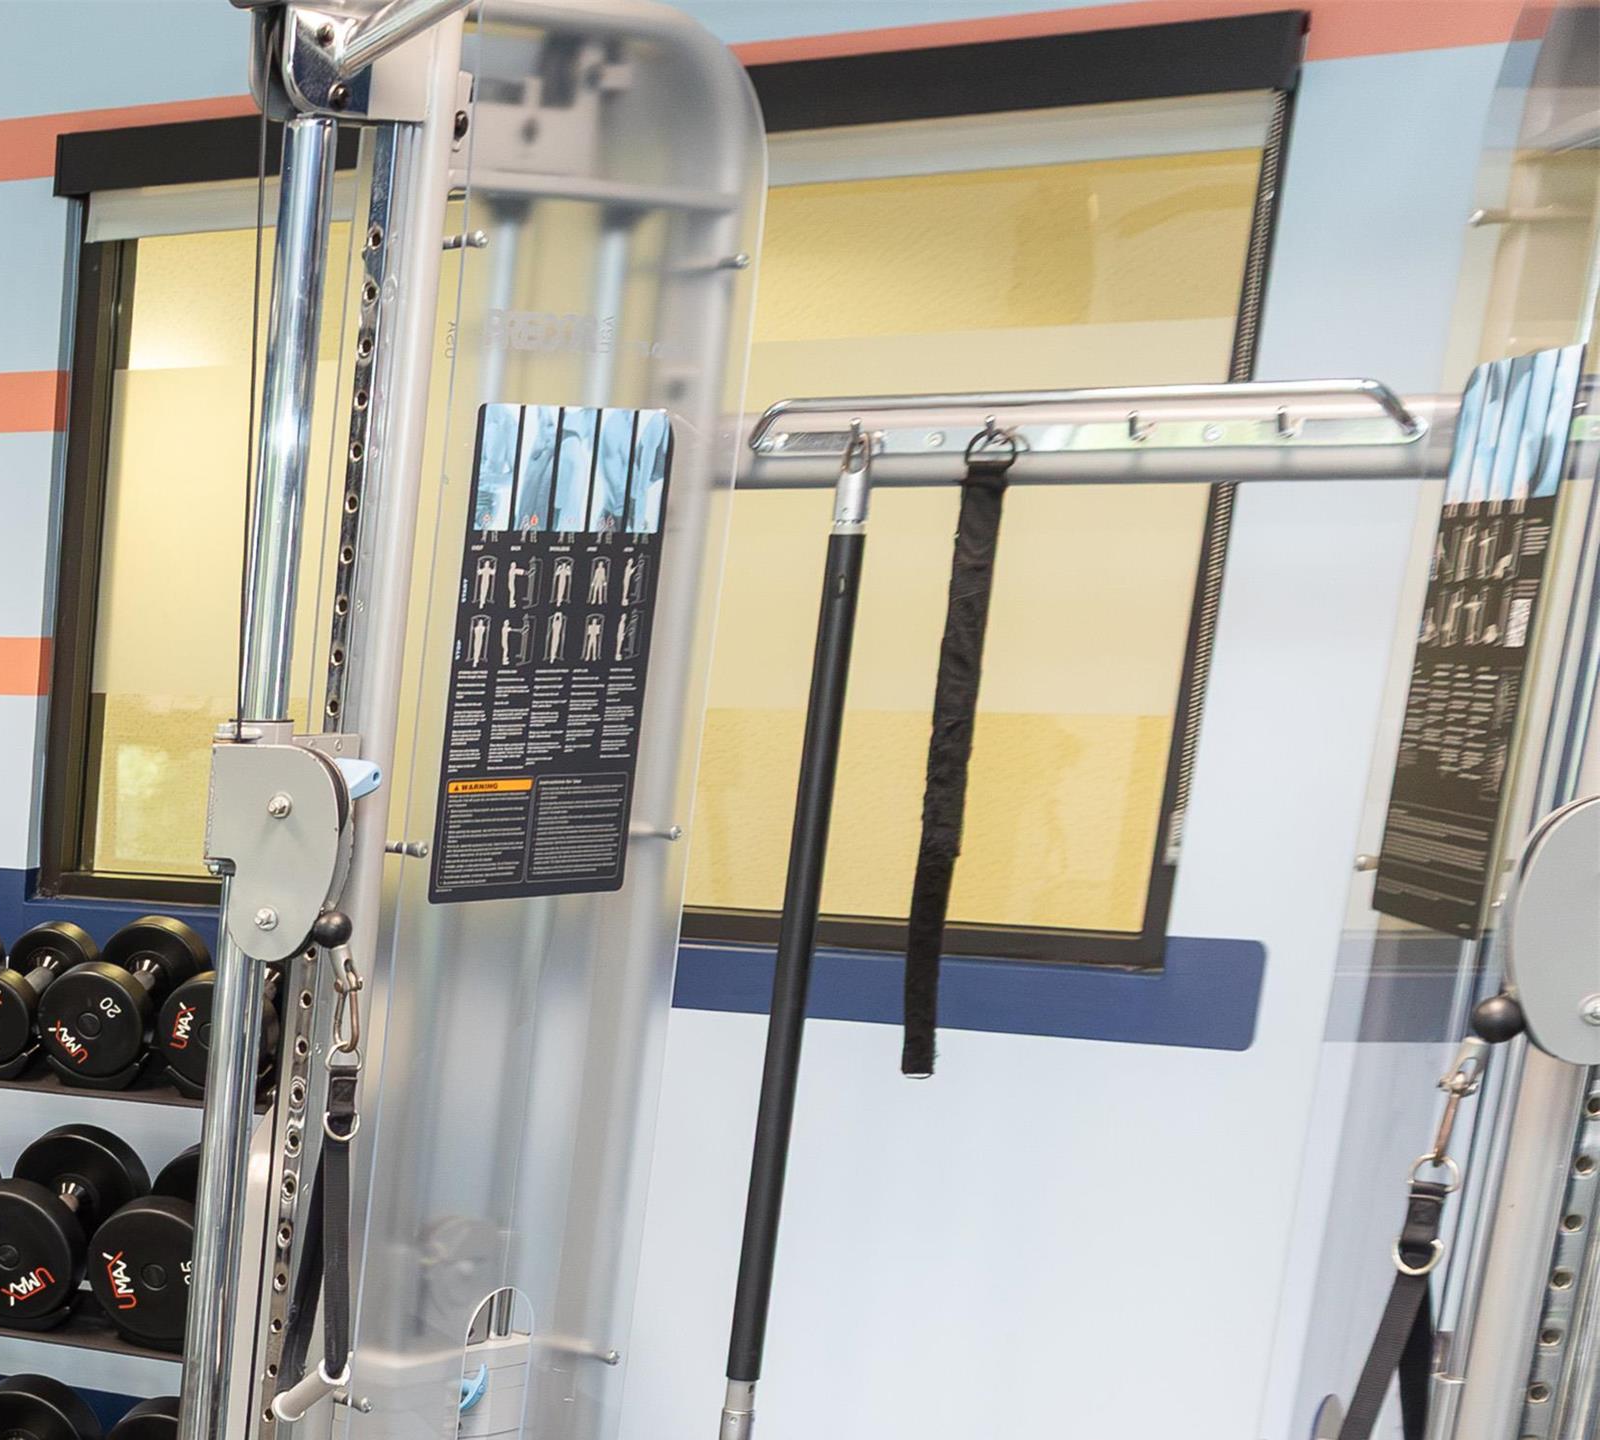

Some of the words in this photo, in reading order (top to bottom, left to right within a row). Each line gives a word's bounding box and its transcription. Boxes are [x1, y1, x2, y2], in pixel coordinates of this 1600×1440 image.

[461, 782, 499, 791] WARNING
[99, 997, 122, 1019] 20
[169, 1001, 197, 1050] UMAX
[47, 1020, 88, 1064] UMAX
[1, 1267, 55, 1307] UMAX
[102, 1251, 137, 1309] UMAX
